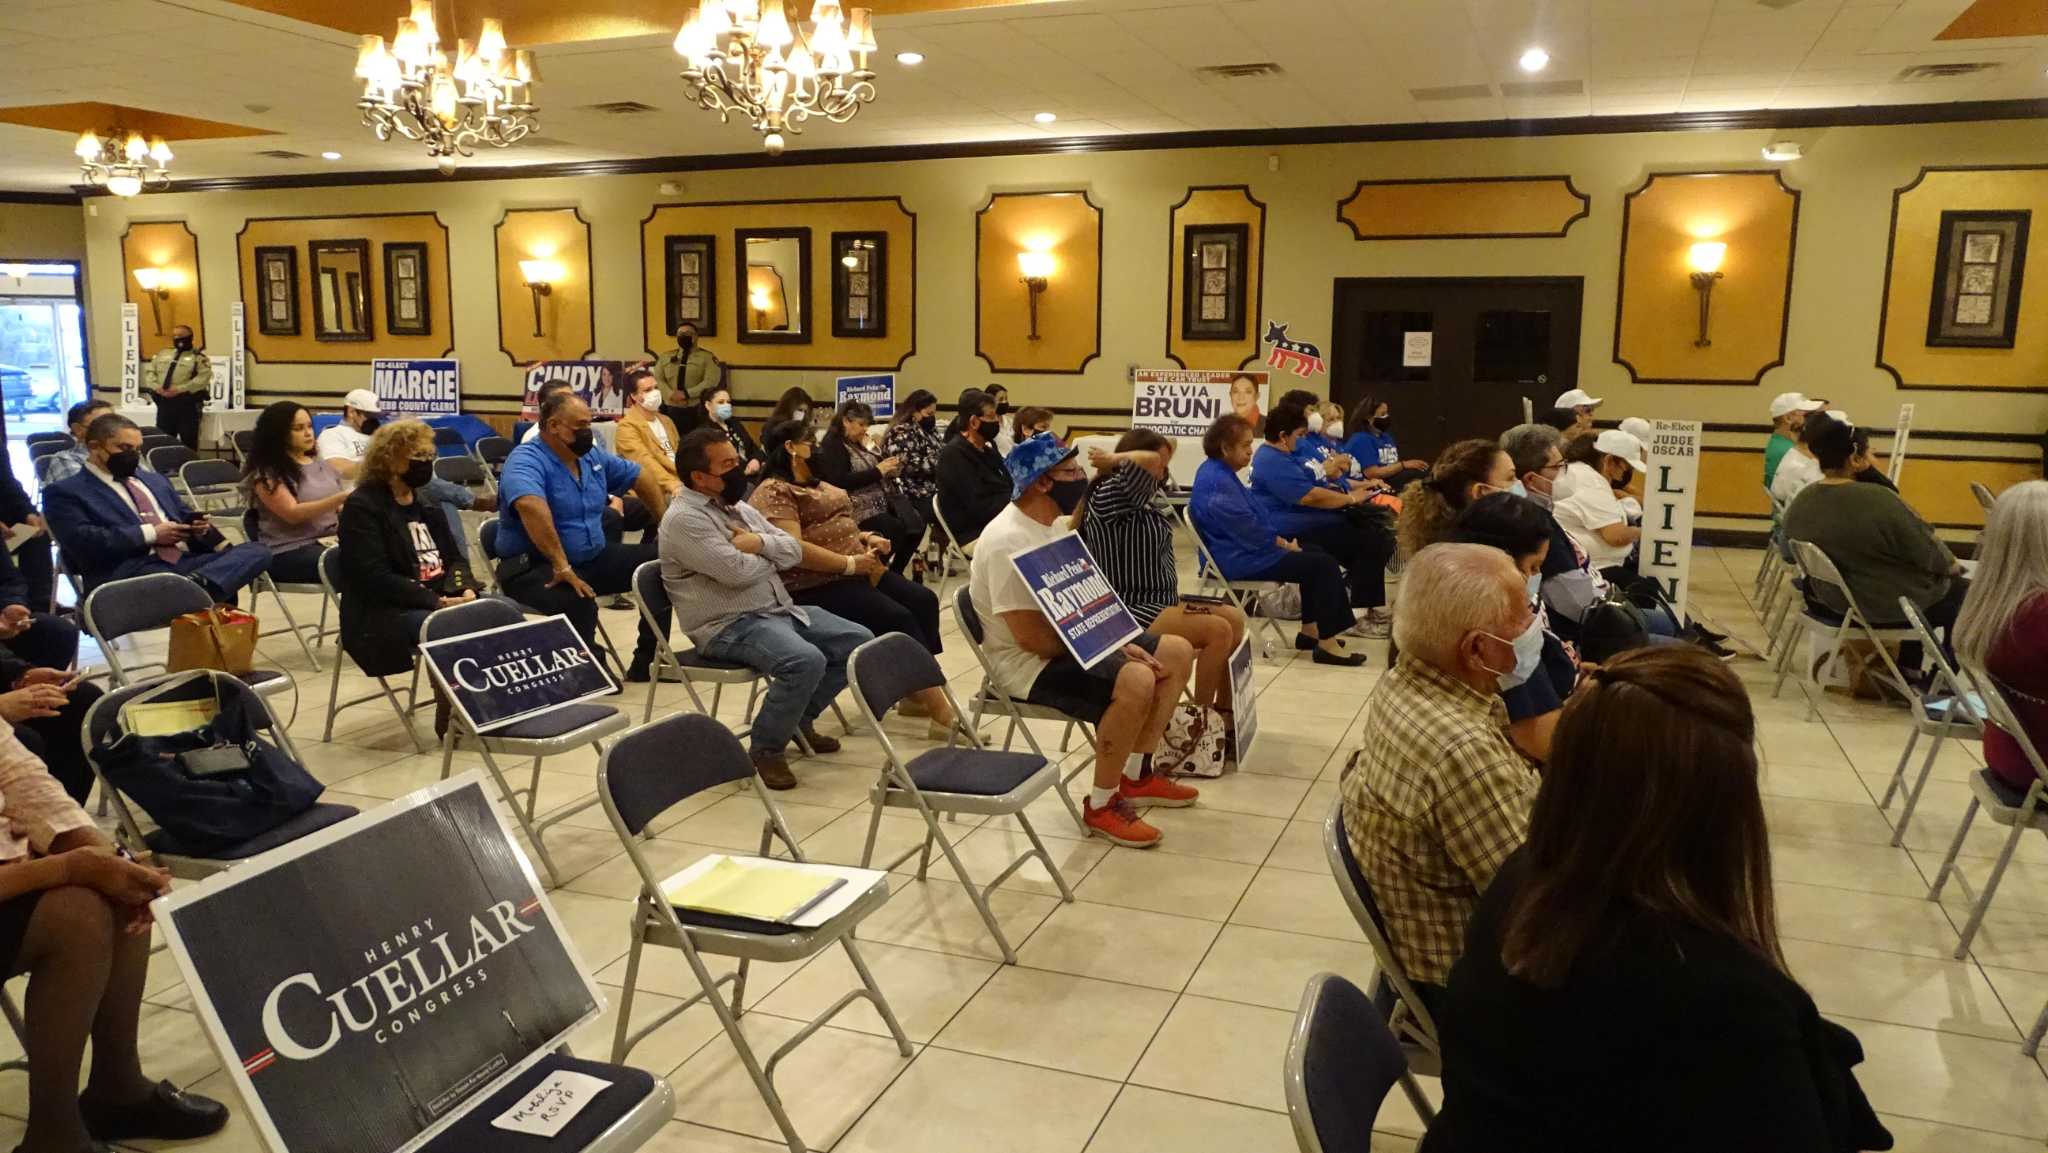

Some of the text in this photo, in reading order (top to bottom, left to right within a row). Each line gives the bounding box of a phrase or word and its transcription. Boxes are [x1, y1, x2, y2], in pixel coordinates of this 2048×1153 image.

[233, 320, 243, 406] LIENDO
[375, 369, 455, 400] MARGIE
[527, 365, 602, 392] CINDY
[839, 388, 891, 403] Raymond
[1147, 385, 1209, 397] SYLVIA
[380, 401, 455, 411] EBB COUNTY CLERK
[1135, 397, 1221, 418] BRUNI
[1656, 421, 1695, 431] Re-Elect
[1652, 445, 1695, 456] OSCAR
[1653, 434, 1695, 446] JUDGE
[1037, 565, 1111, 621] Raymond
[1068, 622, 1088, 640] STATE
[497, 647, 533, 661] HENRY
[452, 647, 590, 693] CUELLAR
[507, 673, 565, 694] CONGRESS
[364, 917, 435, 964] HENRY
[262, 900, 535, 1060] CUELLAR
[374, 968, 488, 1044] CONGRESS
[540, 1090, 574, 1122] RSVP
